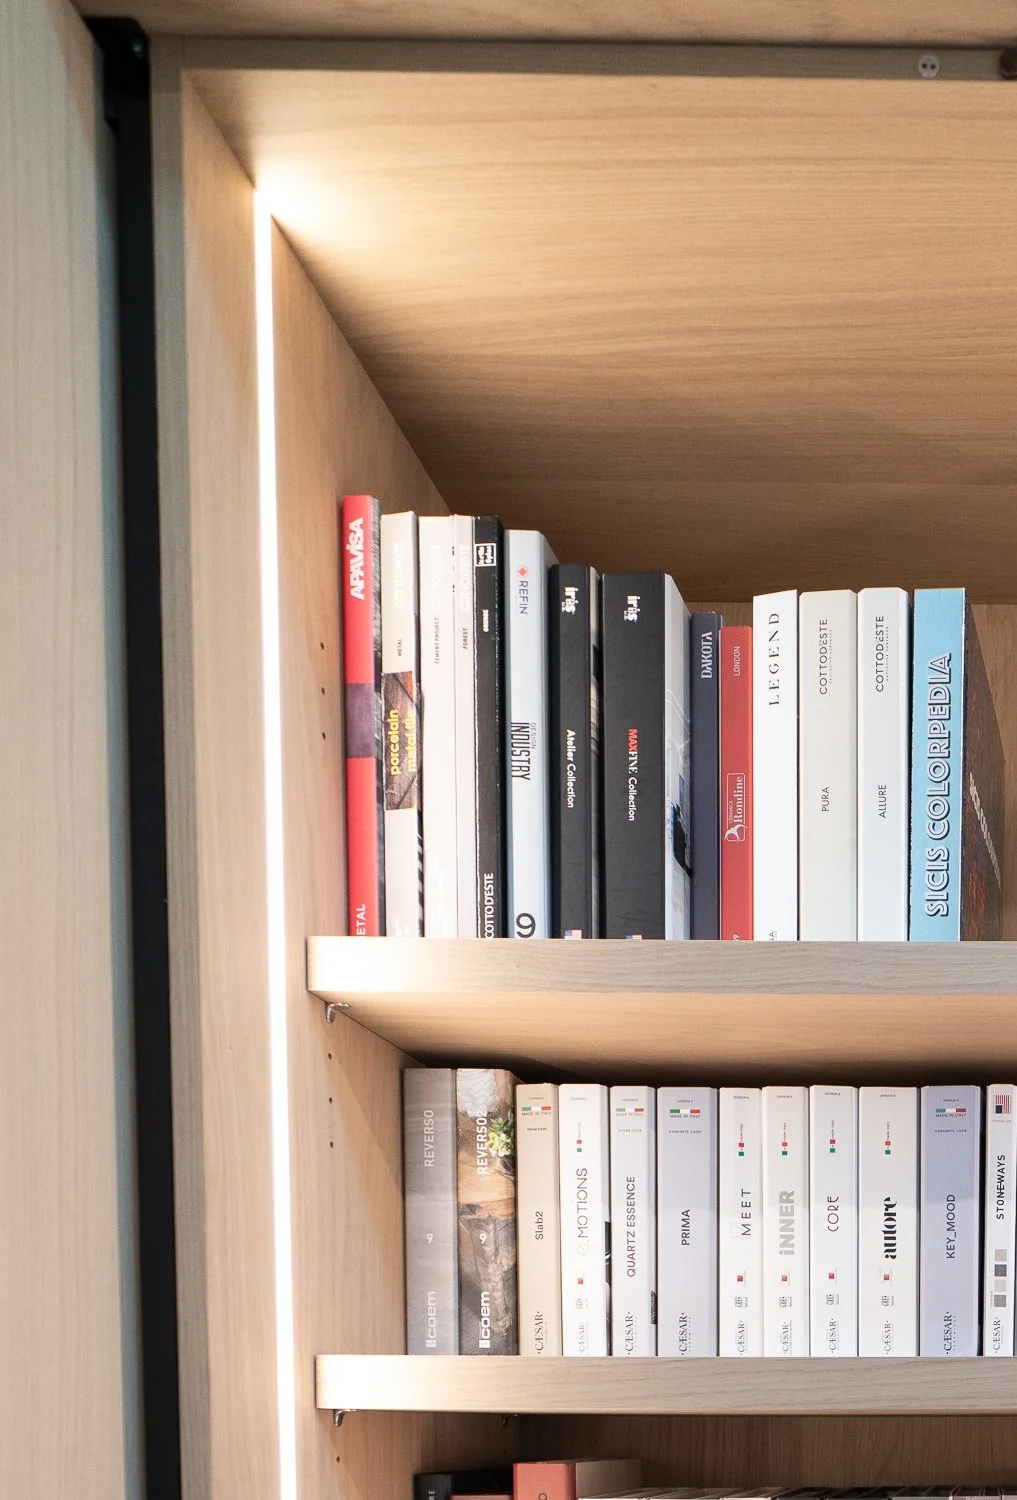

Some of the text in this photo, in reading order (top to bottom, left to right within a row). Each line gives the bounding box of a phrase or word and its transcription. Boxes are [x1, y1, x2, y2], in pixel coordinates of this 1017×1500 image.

[519, 581, 528, 614] REFIN
[702, 631, 713, 679] DAKOTA
[769, 613, 780, 706] LEGEND
[387, 708, 401, 776] porcelain
[511, 722, 530, 781] INDUSTRY
[567, 730, 576, 808] Atelier Collection
[629, 729, 638, 821] MAXFINE Collection
[926, 653, 952, 917] SICIS COLORPEDIA
[733, 776, 743, 824] Rondine
[822, 786, 830, 812] PURA
[879, 784, 887, 818] ALLURE
[424, 1109, 434, 1167] REVERSO
[477, 1110, 488, 1175] REVERSO2
[741, 1188, 751, 1236] MEET
[996, 1155, 1005, 1219] STONEWAYS
[427, 1233, 433, 1243] 9
[480, 1233, 486, 1243] 9
[627, 1176, 635, 1277] QUARTZ ESSENCE
[681, 1209, 690, 1245] PRIMA
[827, 1196, 839, 1232] CORE
[884, 1196, 897, 1259] autore
[946, 1194, 957, 1259] KEY_MOOD
[427, 1291, 437, 1338] coem
[480, 1292, 490, 1339] coem
